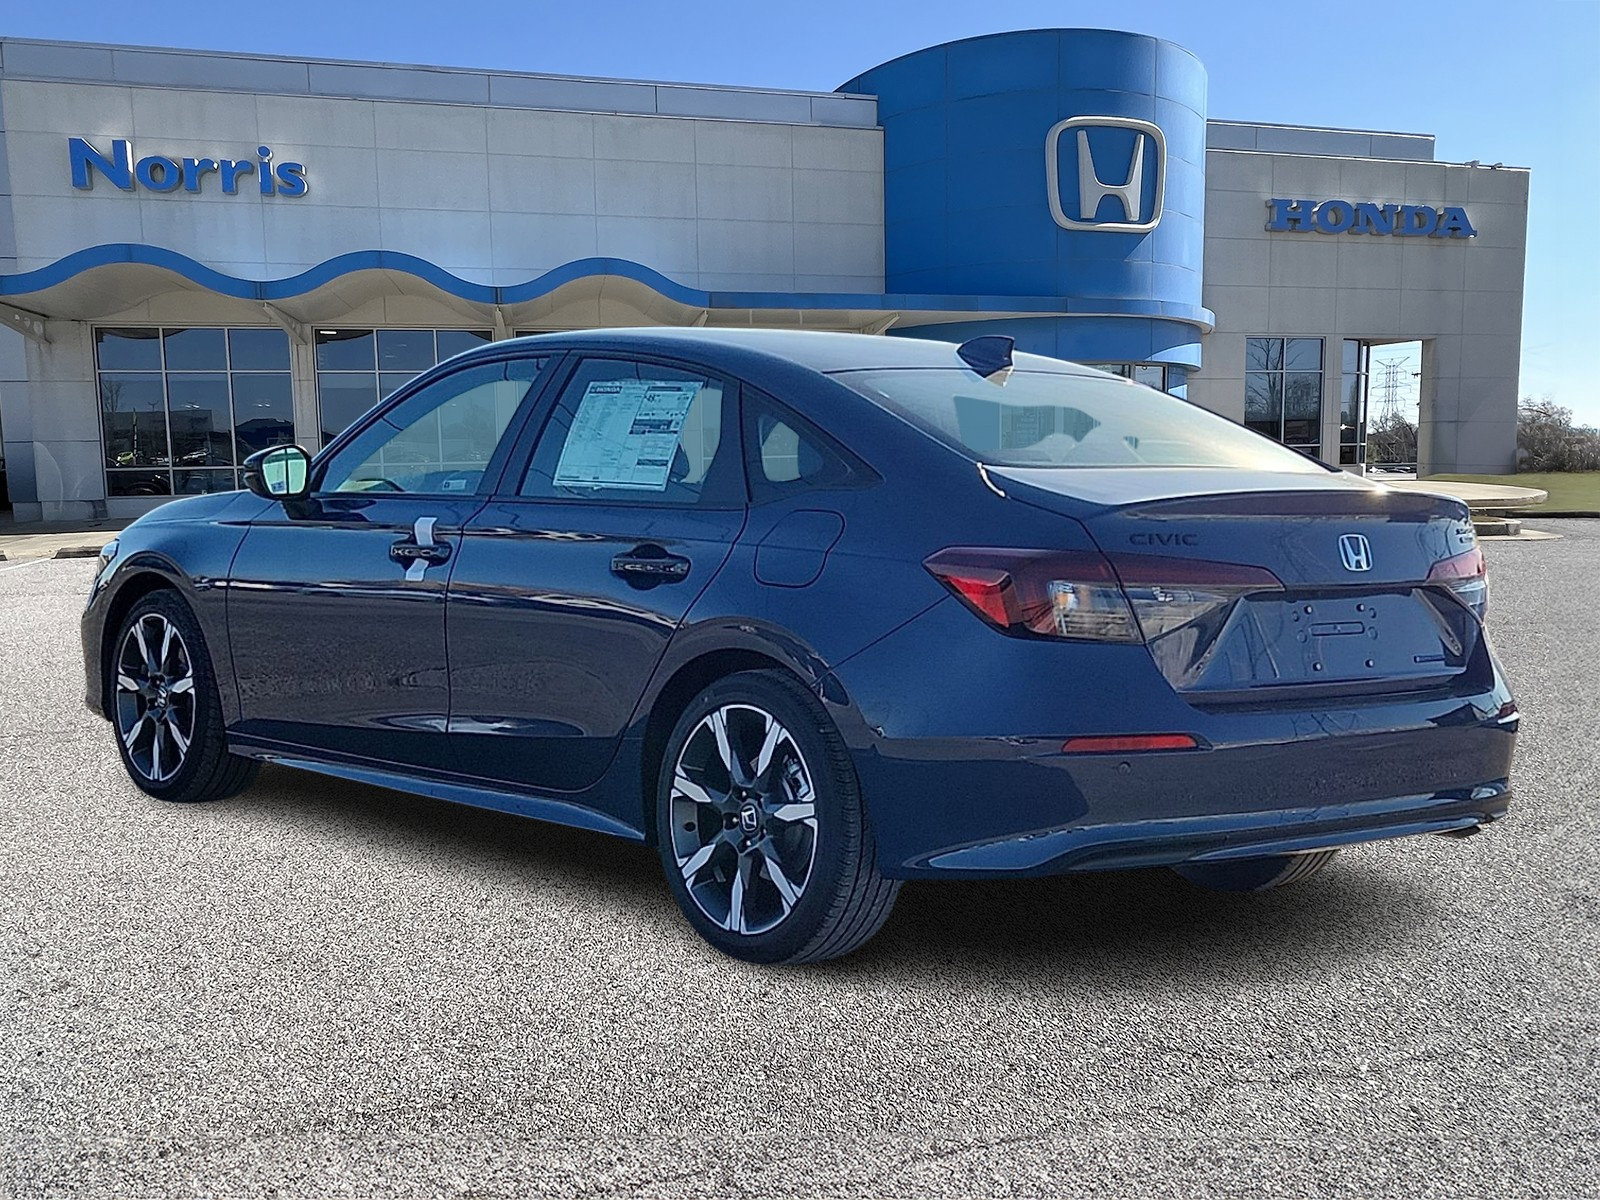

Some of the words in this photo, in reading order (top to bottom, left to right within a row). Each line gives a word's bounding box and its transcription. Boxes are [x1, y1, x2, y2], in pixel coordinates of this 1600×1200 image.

[68, 137, 309, 197] Norris
[1266, 198, 1478, 239] HONDA
[1129, 533, 1198, 546] CIVIC
